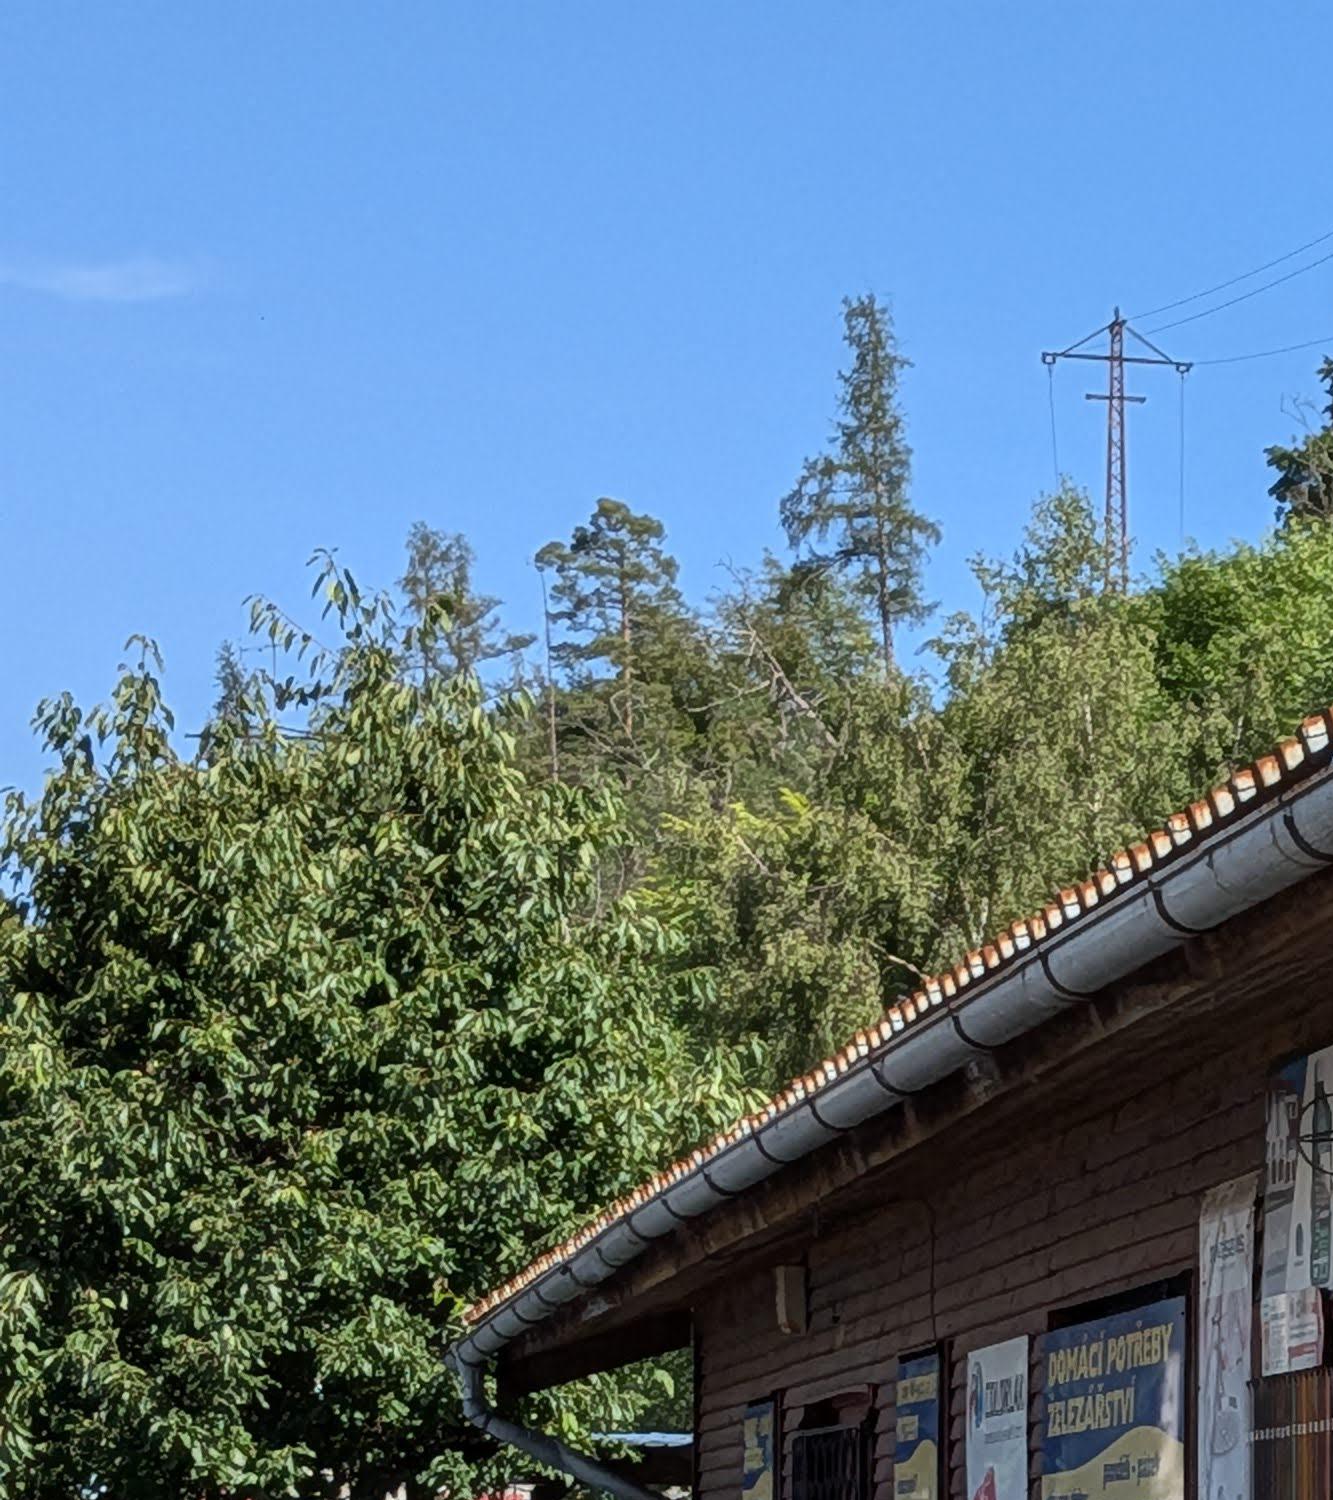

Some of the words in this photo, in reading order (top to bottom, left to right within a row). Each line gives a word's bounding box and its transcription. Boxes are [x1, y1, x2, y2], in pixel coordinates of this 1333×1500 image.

[1047, 1329, 1106, 1387] DOMÁCÍ
[1107, 1320, 1174, 1376] POTŘEBY
[1047, 1375, 1137, 1439] ŽELEZÁŘSTVÍ
